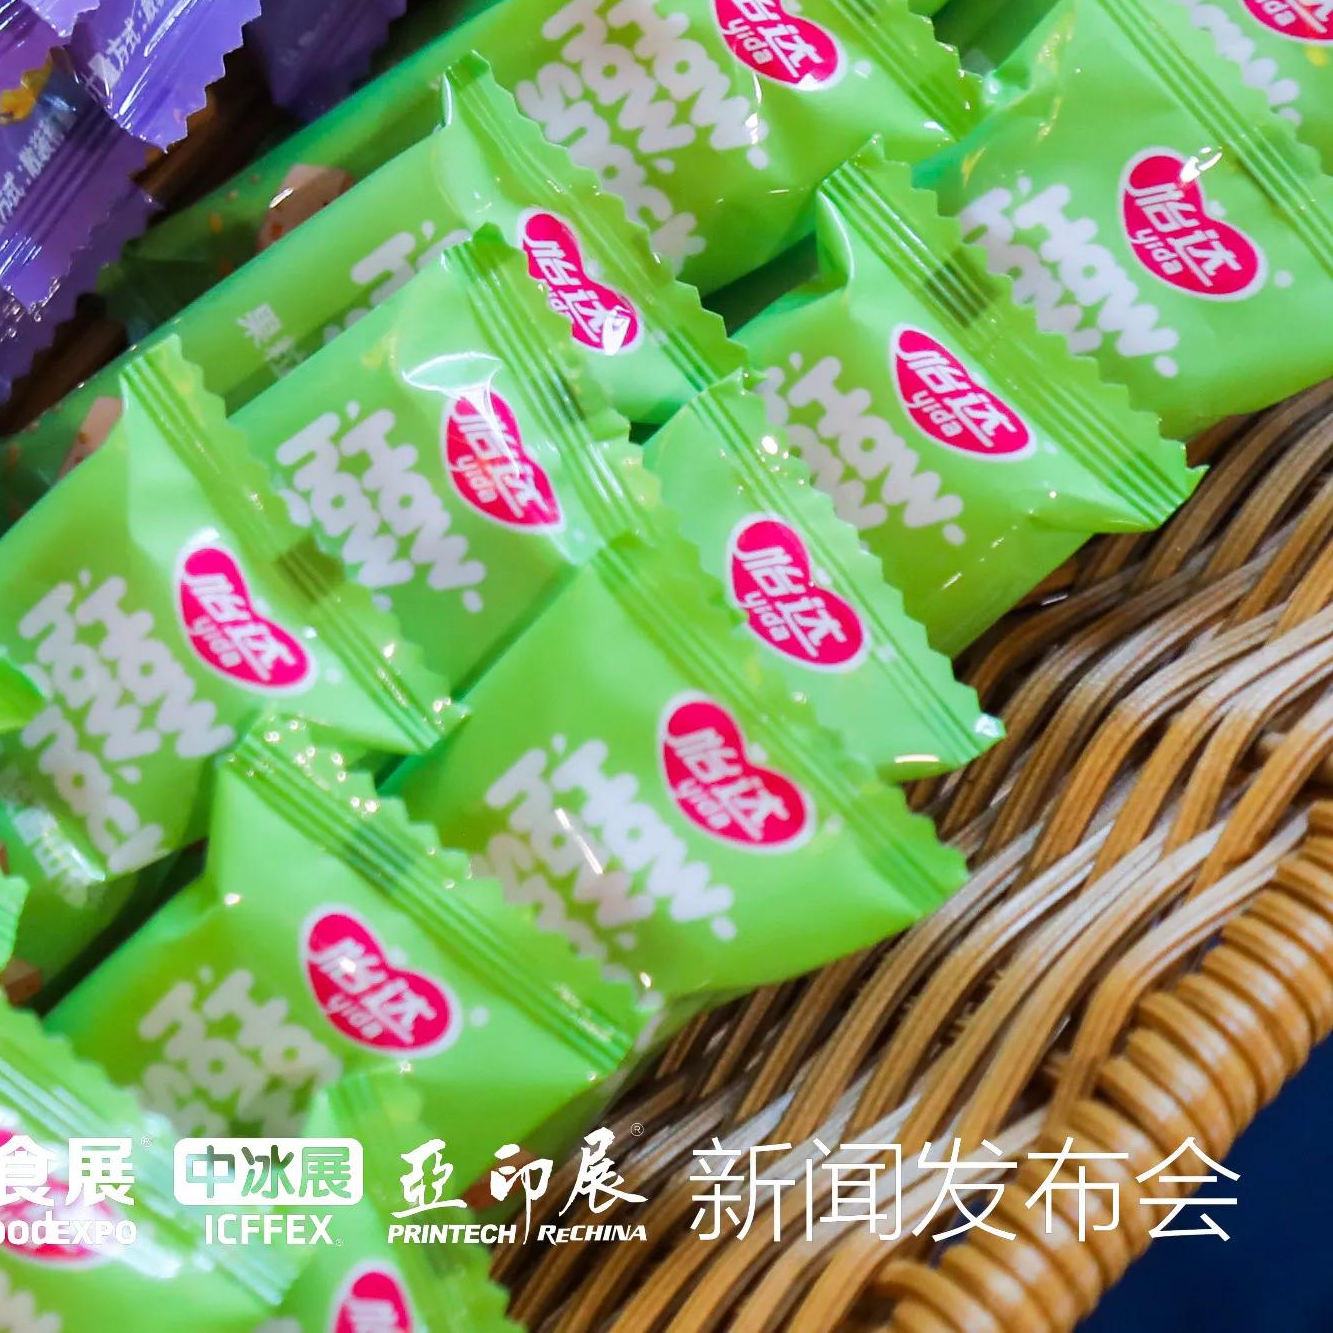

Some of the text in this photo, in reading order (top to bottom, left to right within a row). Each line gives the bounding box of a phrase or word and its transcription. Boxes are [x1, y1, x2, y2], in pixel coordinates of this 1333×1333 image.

[723, 15, 771, 66] yida
[1130, 180, 1242, 292] 怡达
[1130, 223, 1180, 277] yida
[897, 347, 1019, 449] 怡达
[910, 389, 962, 439] yida
[183, 570, 297, 683] 怡达
[735, 545, 849, 659] 怡达
[665, 729, 791, 840] 怡达
